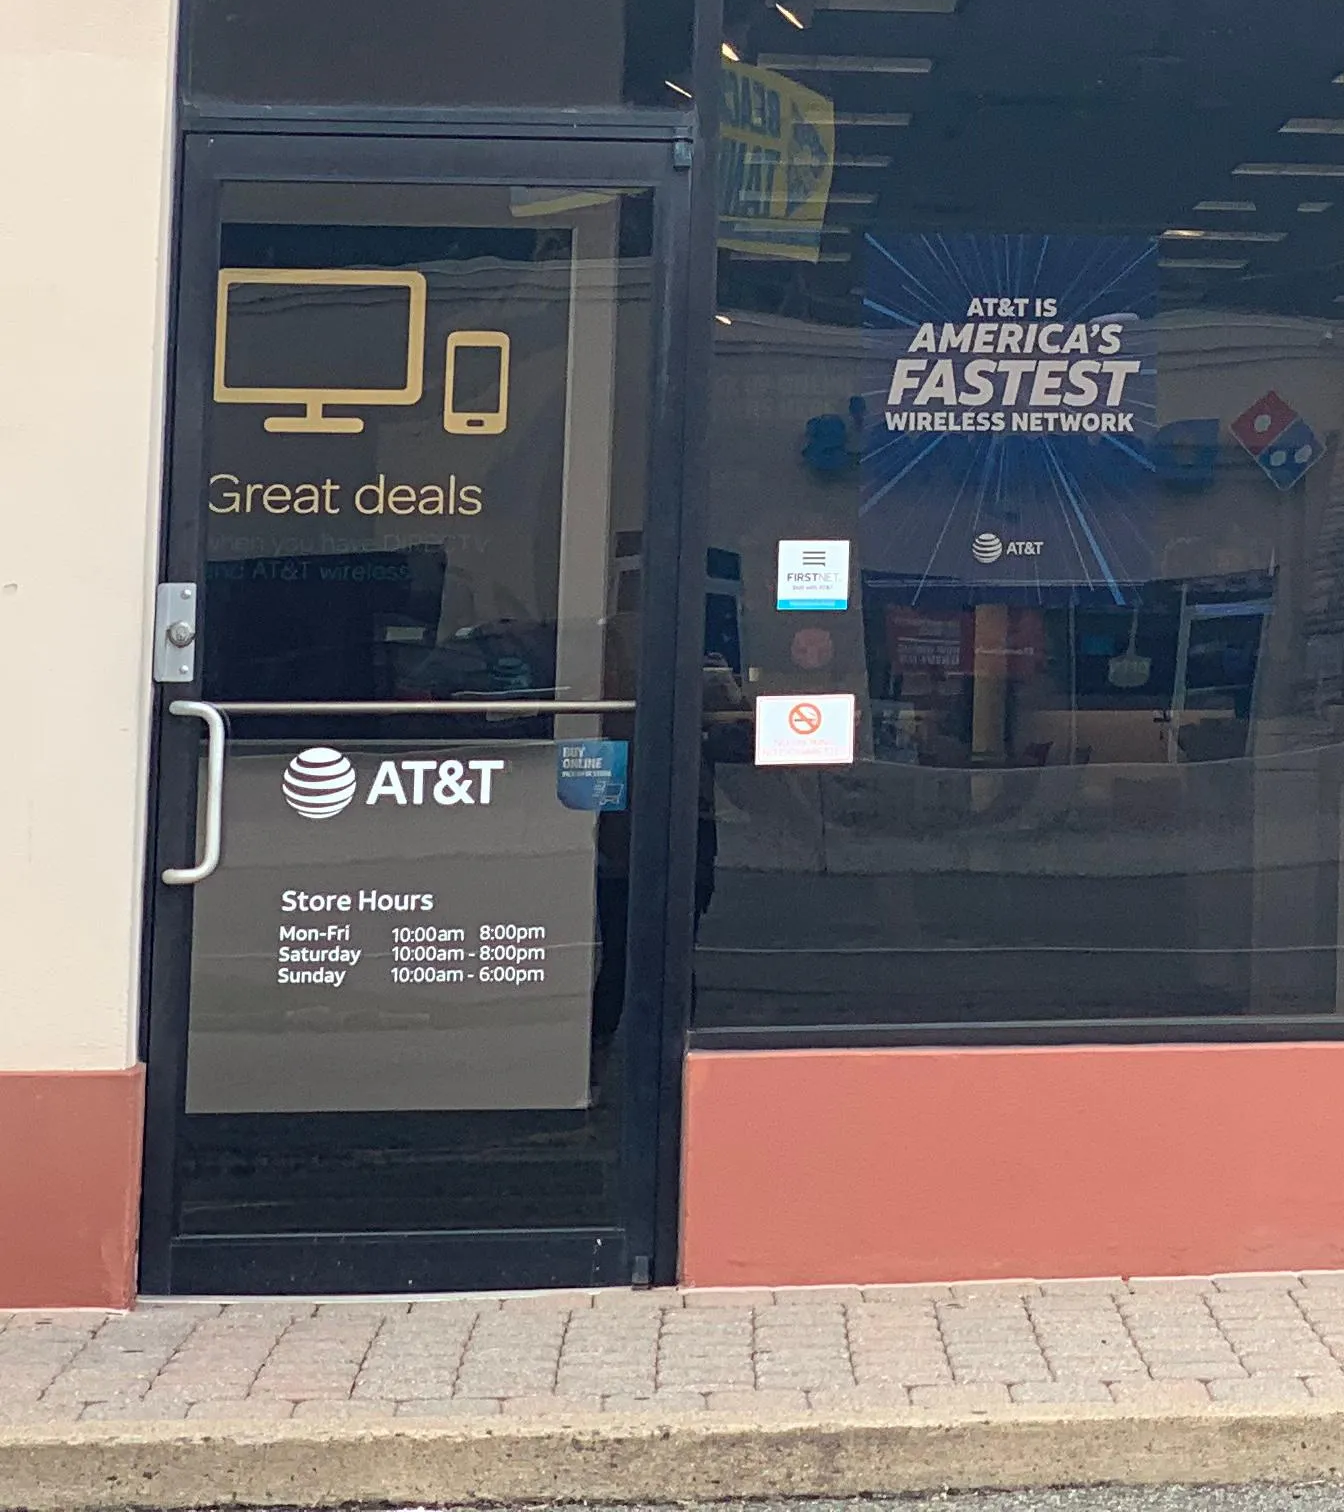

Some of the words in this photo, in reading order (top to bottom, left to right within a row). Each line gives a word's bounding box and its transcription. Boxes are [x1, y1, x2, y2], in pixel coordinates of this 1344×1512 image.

[967, 298, 1029, 318] AT&T
[1035, 298, 1057, 318] IS
[908, 323, 1123, 355] AMERICA'S
[887, 359, 1141, 407] FASTEST
[885, 412, 1005, 432] WIRELESS
[1012, 413, 1134, 432] NETWORK
[208, 474, 340, 514] Great
[354, 474, 482, 515] deals
[1007, 542, 1044, 556] AT&T
[562, 745, 586, 758] BUY
[562, 757, 603, 769] ONLINE
[366, 759, 505, 806] AT&T
[281, 890, 351, 912] Store
[358, 890, 433, 912] Hours
[279, 925, 350, 942] Mon-Fri
[391, 927, 464, 943] 10:00am
[479, 924, 546, 943] 8:00pm
[278, 946, 361, 966] Saturday
[391, 946, 464, 962] 10:00am
[479, 945, 546, 965] 8:00pm
[277, 967, 346, 987] Sunday
[391, 968, 464, 983] 10:00am
[478, 967, 545, 985] 6:00pm
